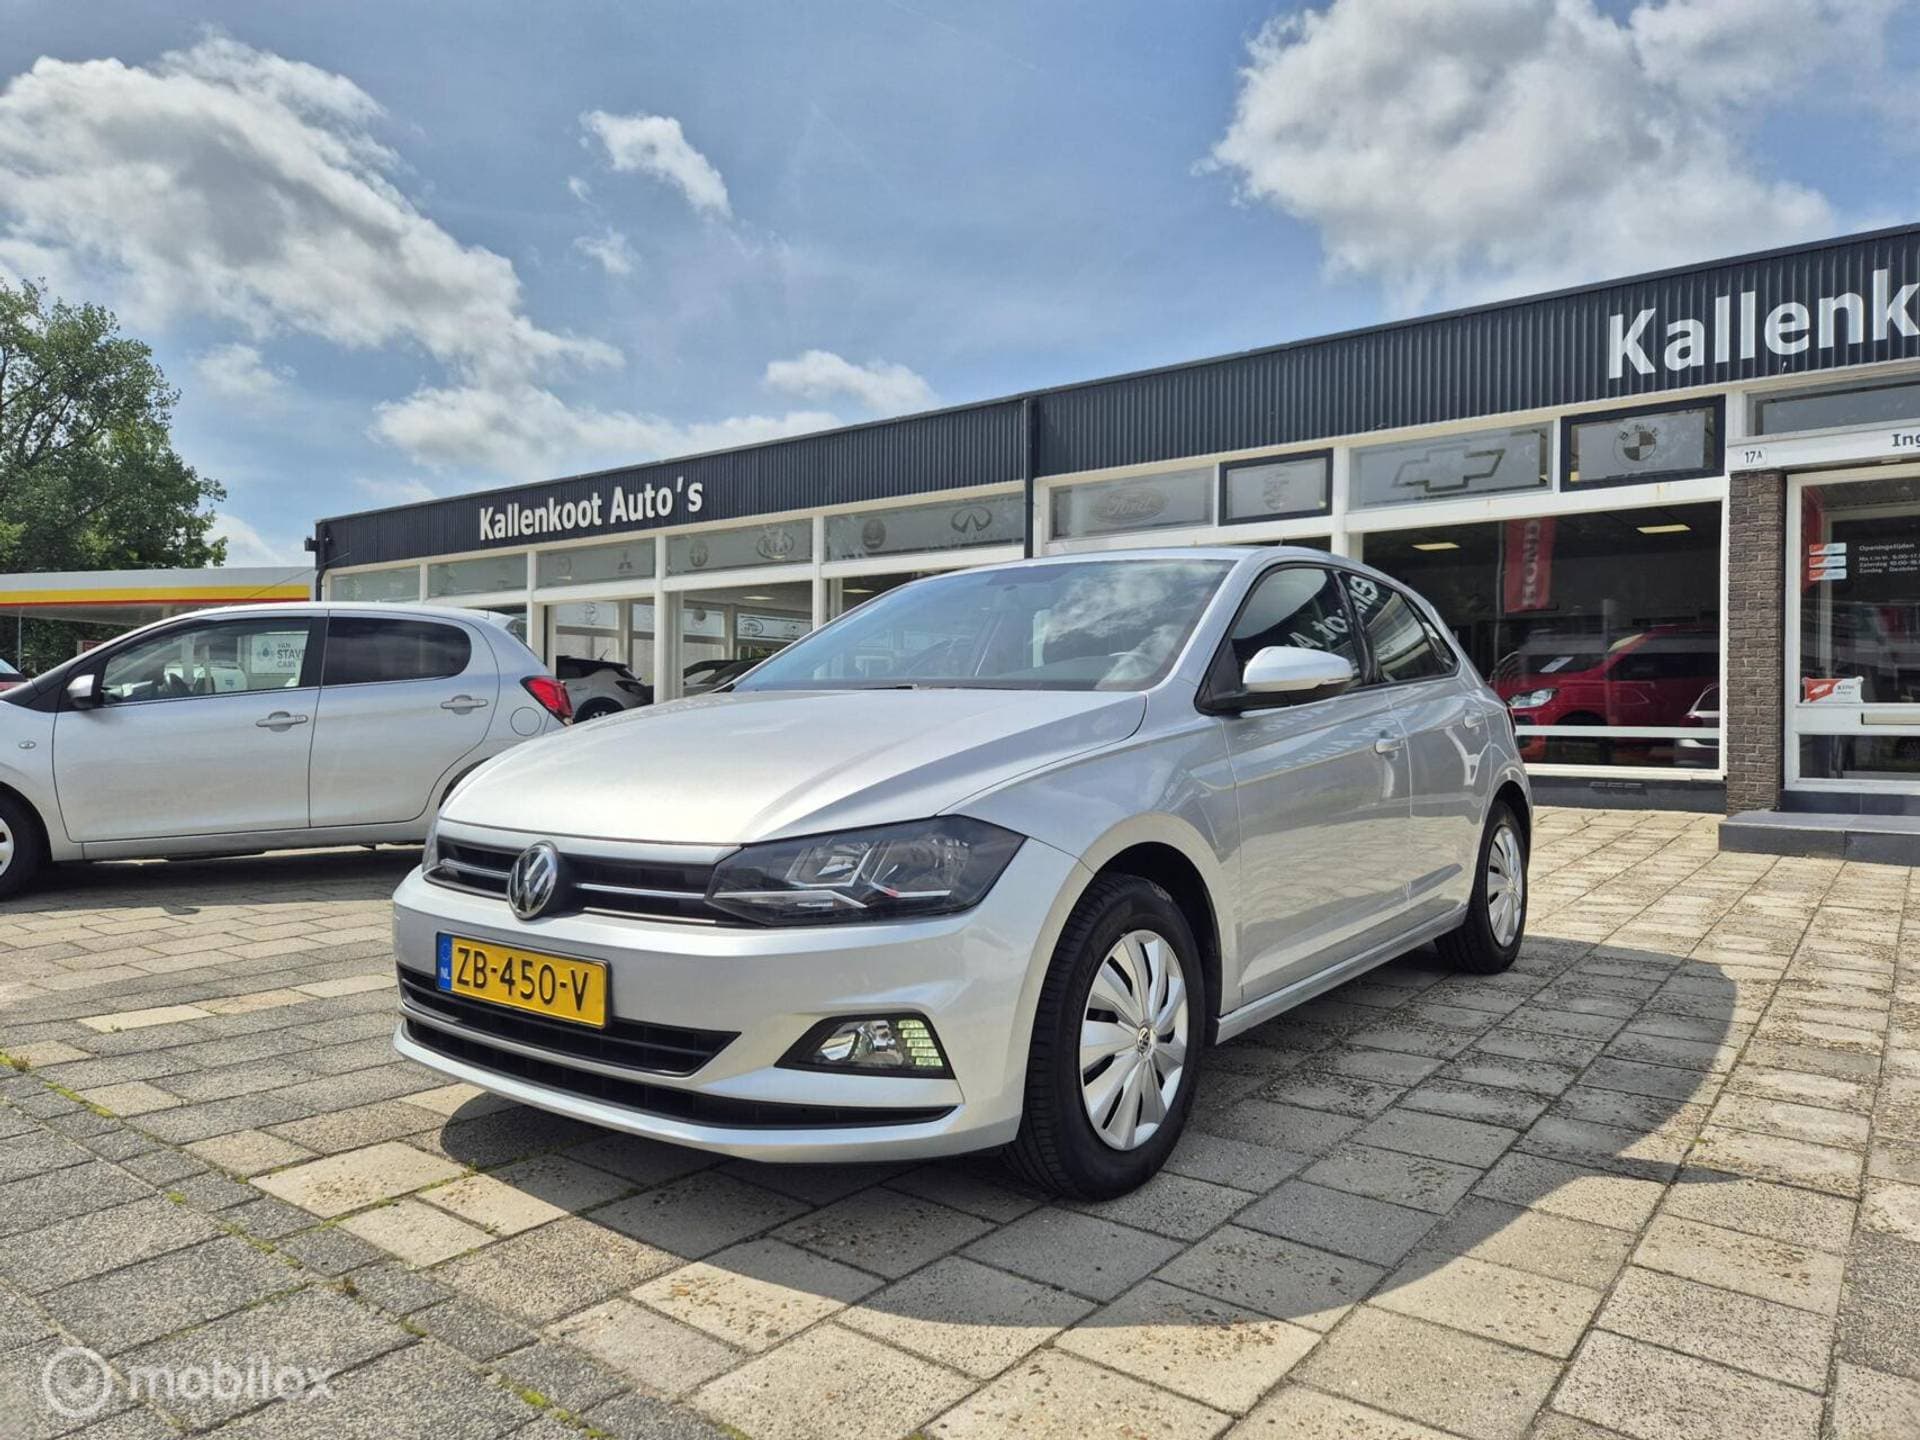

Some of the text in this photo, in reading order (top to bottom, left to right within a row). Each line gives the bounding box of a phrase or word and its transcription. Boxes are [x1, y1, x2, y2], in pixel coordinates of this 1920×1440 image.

[1608, 268, 1920, 379] Kallenk
[479, 476, 703, 541] Kallenkoot Auto's
[457, 947, 589, 1011] ZB-450-V
